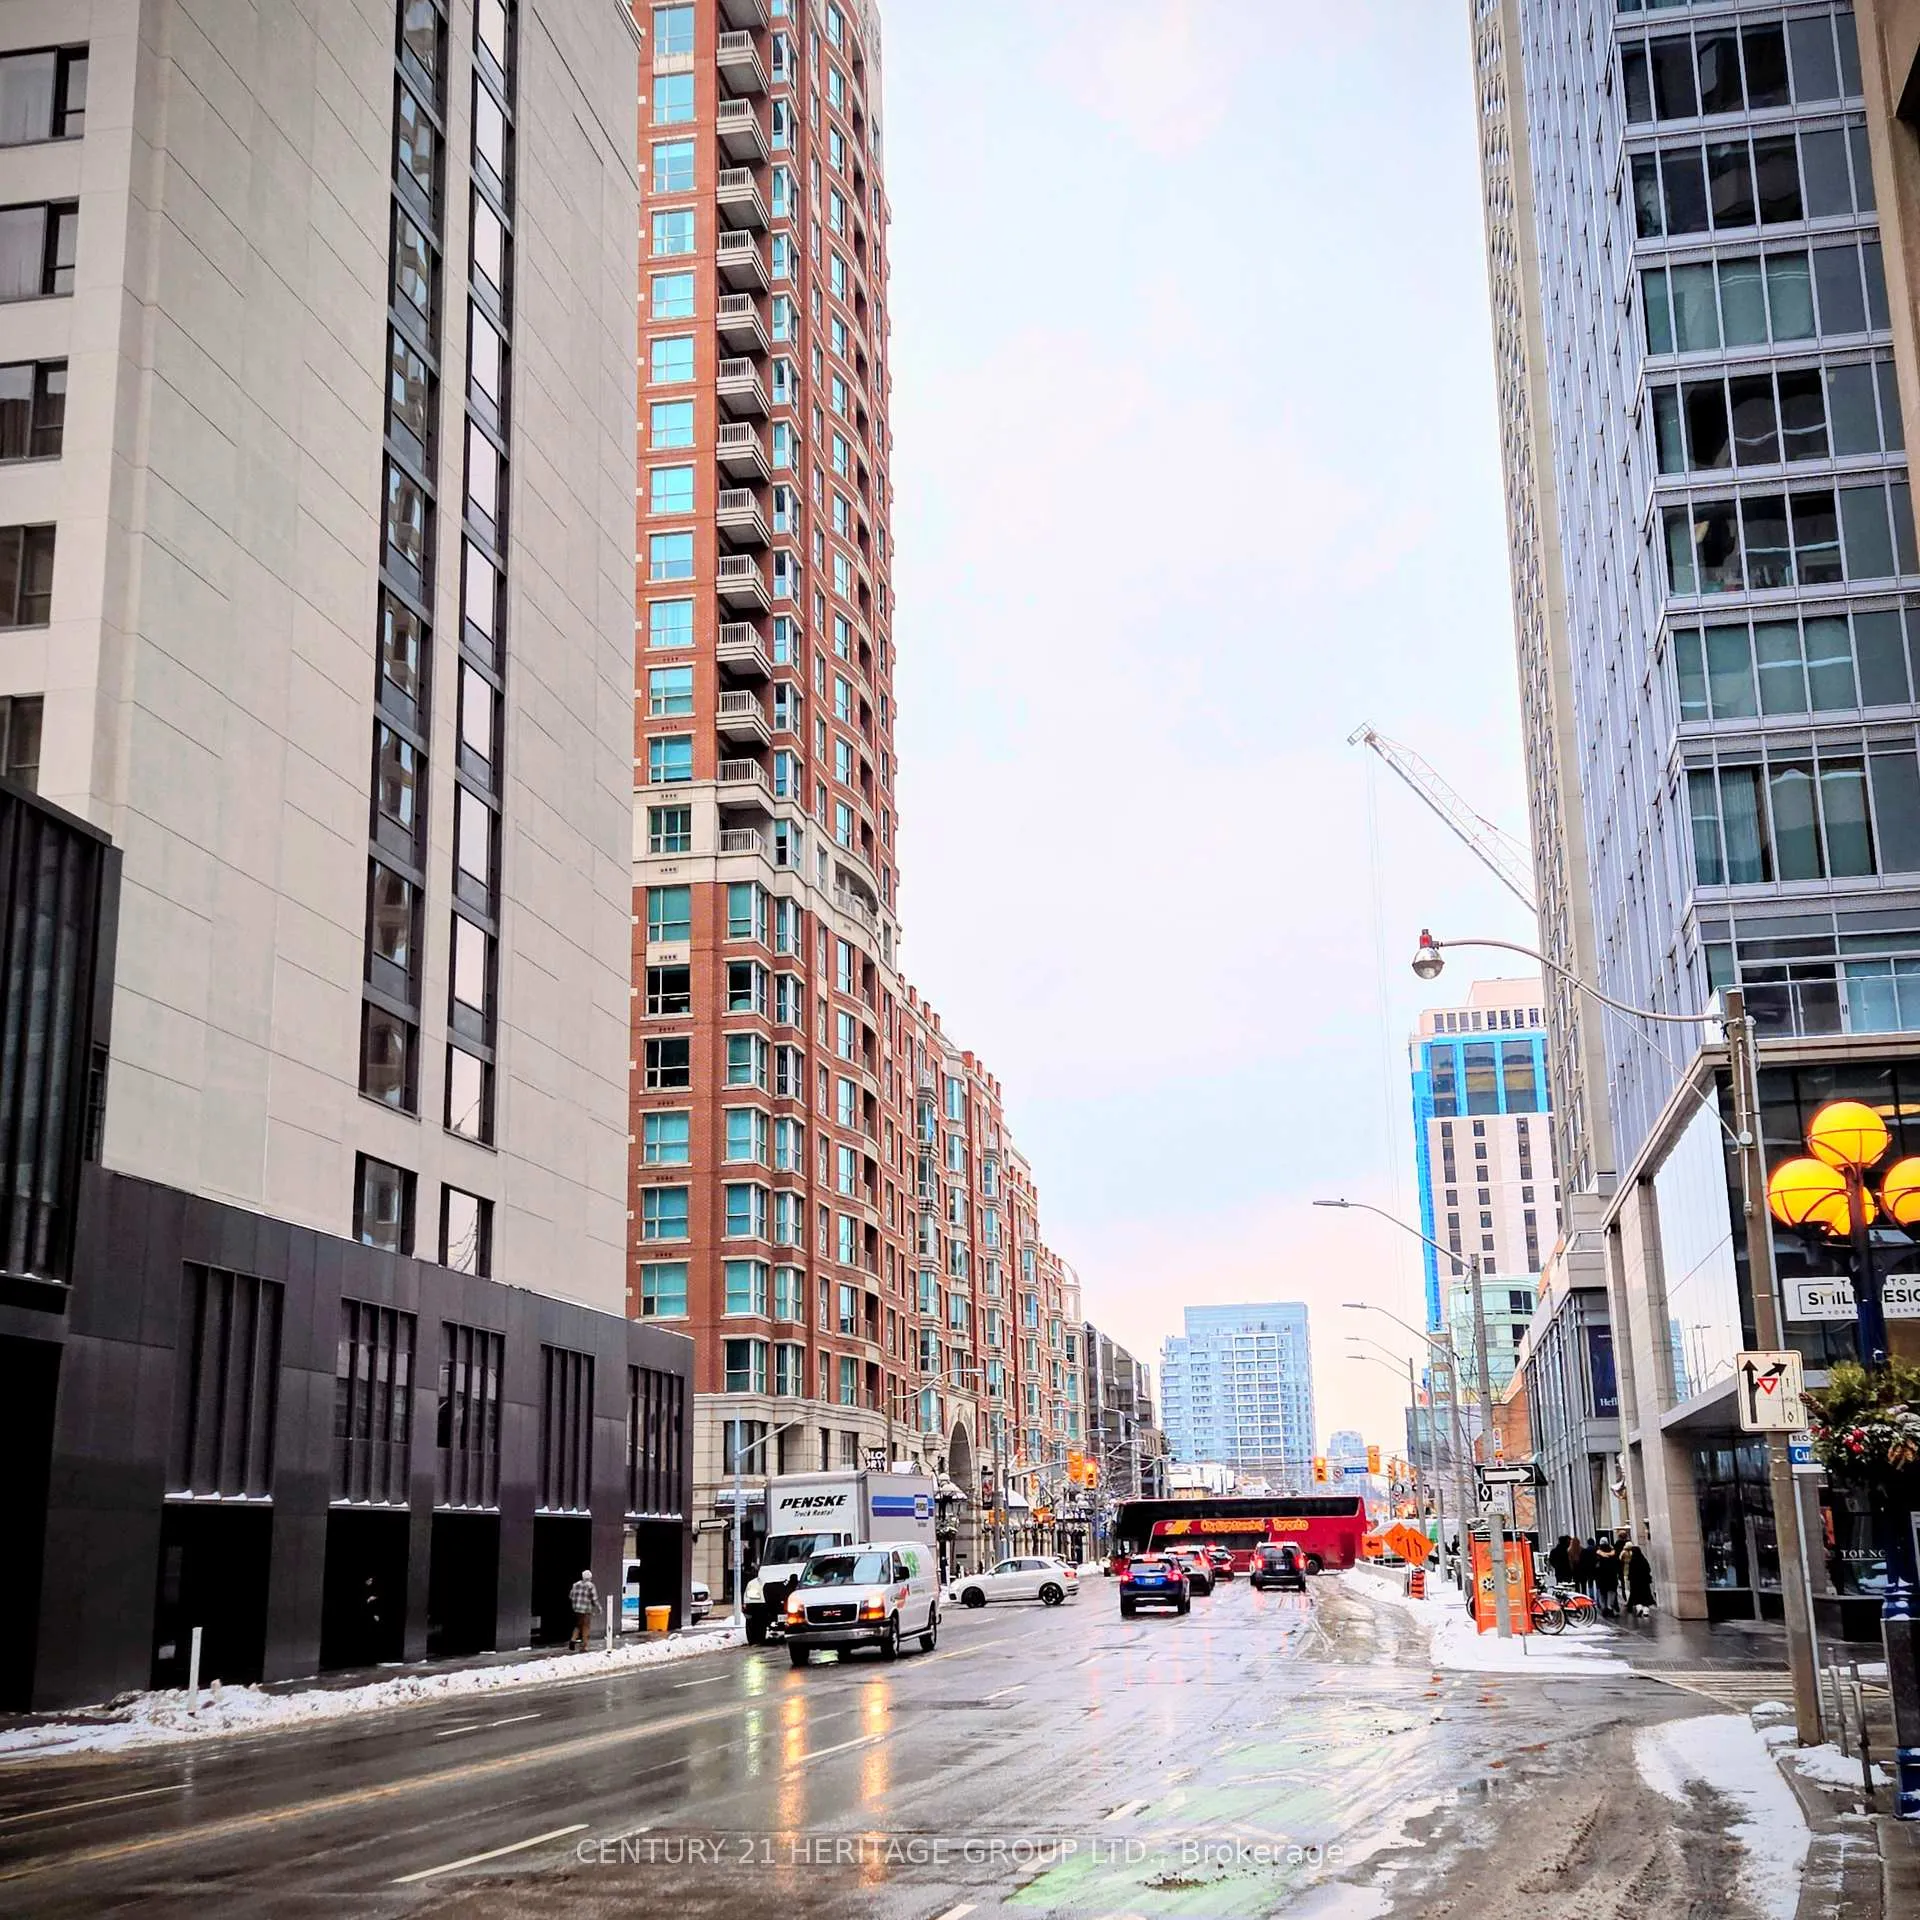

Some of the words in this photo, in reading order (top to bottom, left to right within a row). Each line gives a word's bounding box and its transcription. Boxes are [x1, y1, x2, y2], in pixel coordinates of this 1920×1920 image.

[780, 1495, 848, 1510] PENSKE
[794, 1510, 811, 1518] Truck
[812, 1508, 834, 1517] Rental
